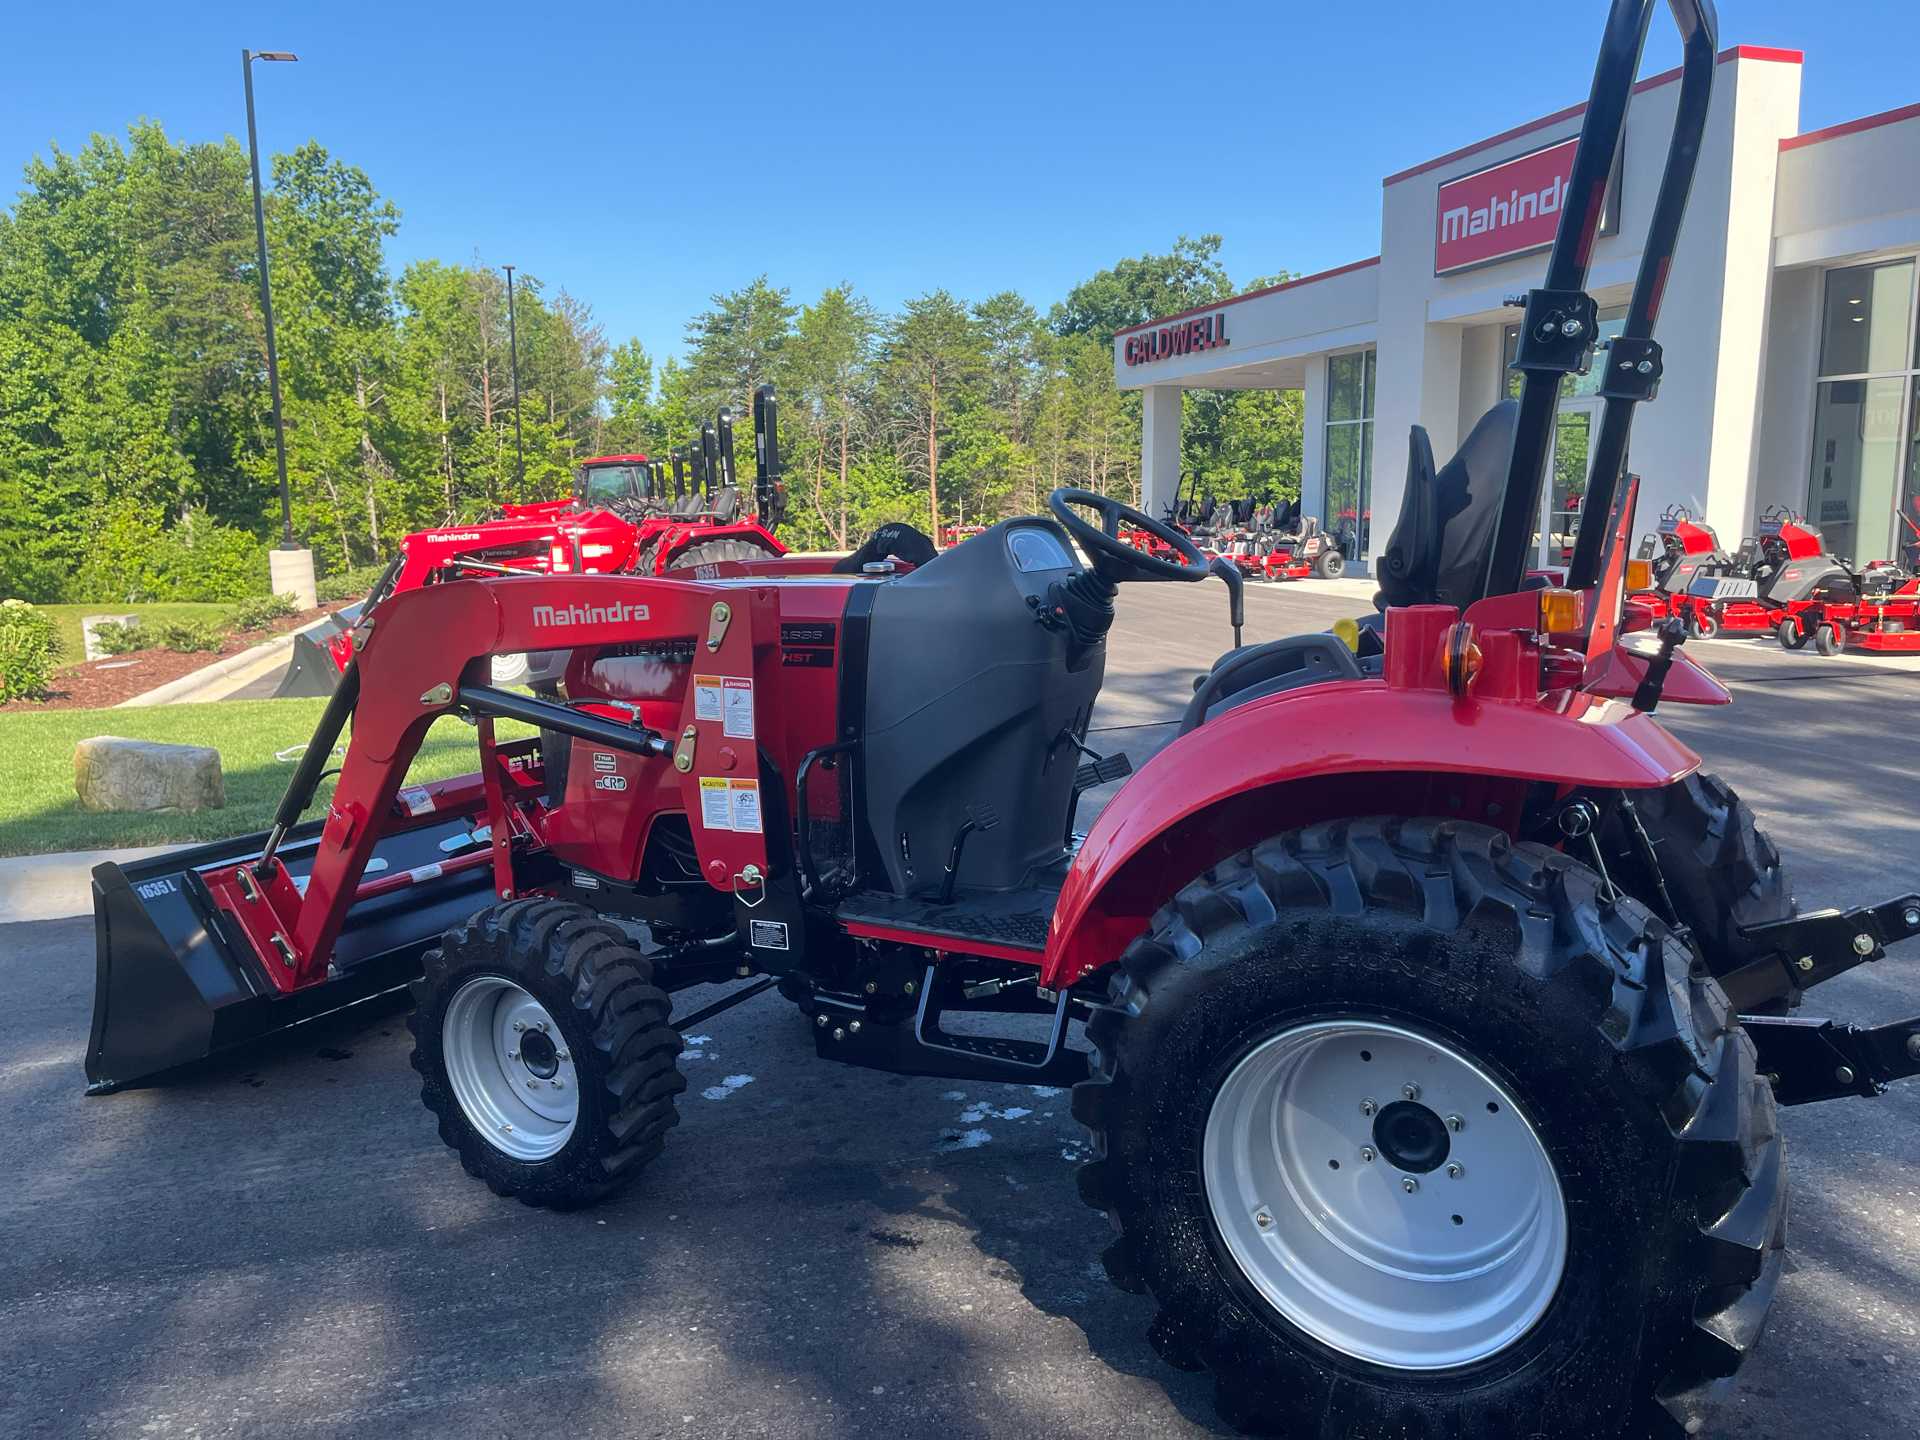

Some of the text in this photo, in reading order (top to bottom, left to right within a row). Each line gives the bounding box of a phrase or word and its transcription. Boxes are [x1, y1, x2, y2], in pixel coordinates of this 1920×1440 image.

[1125, 313, 1230, 366] CALDWELL
[427, 532, 480, 543] Mahindra
[532, 601, 650, 627] Mahindra
[781, 630, 823, 640] 1635
[782, 653, 813, 663] HST
